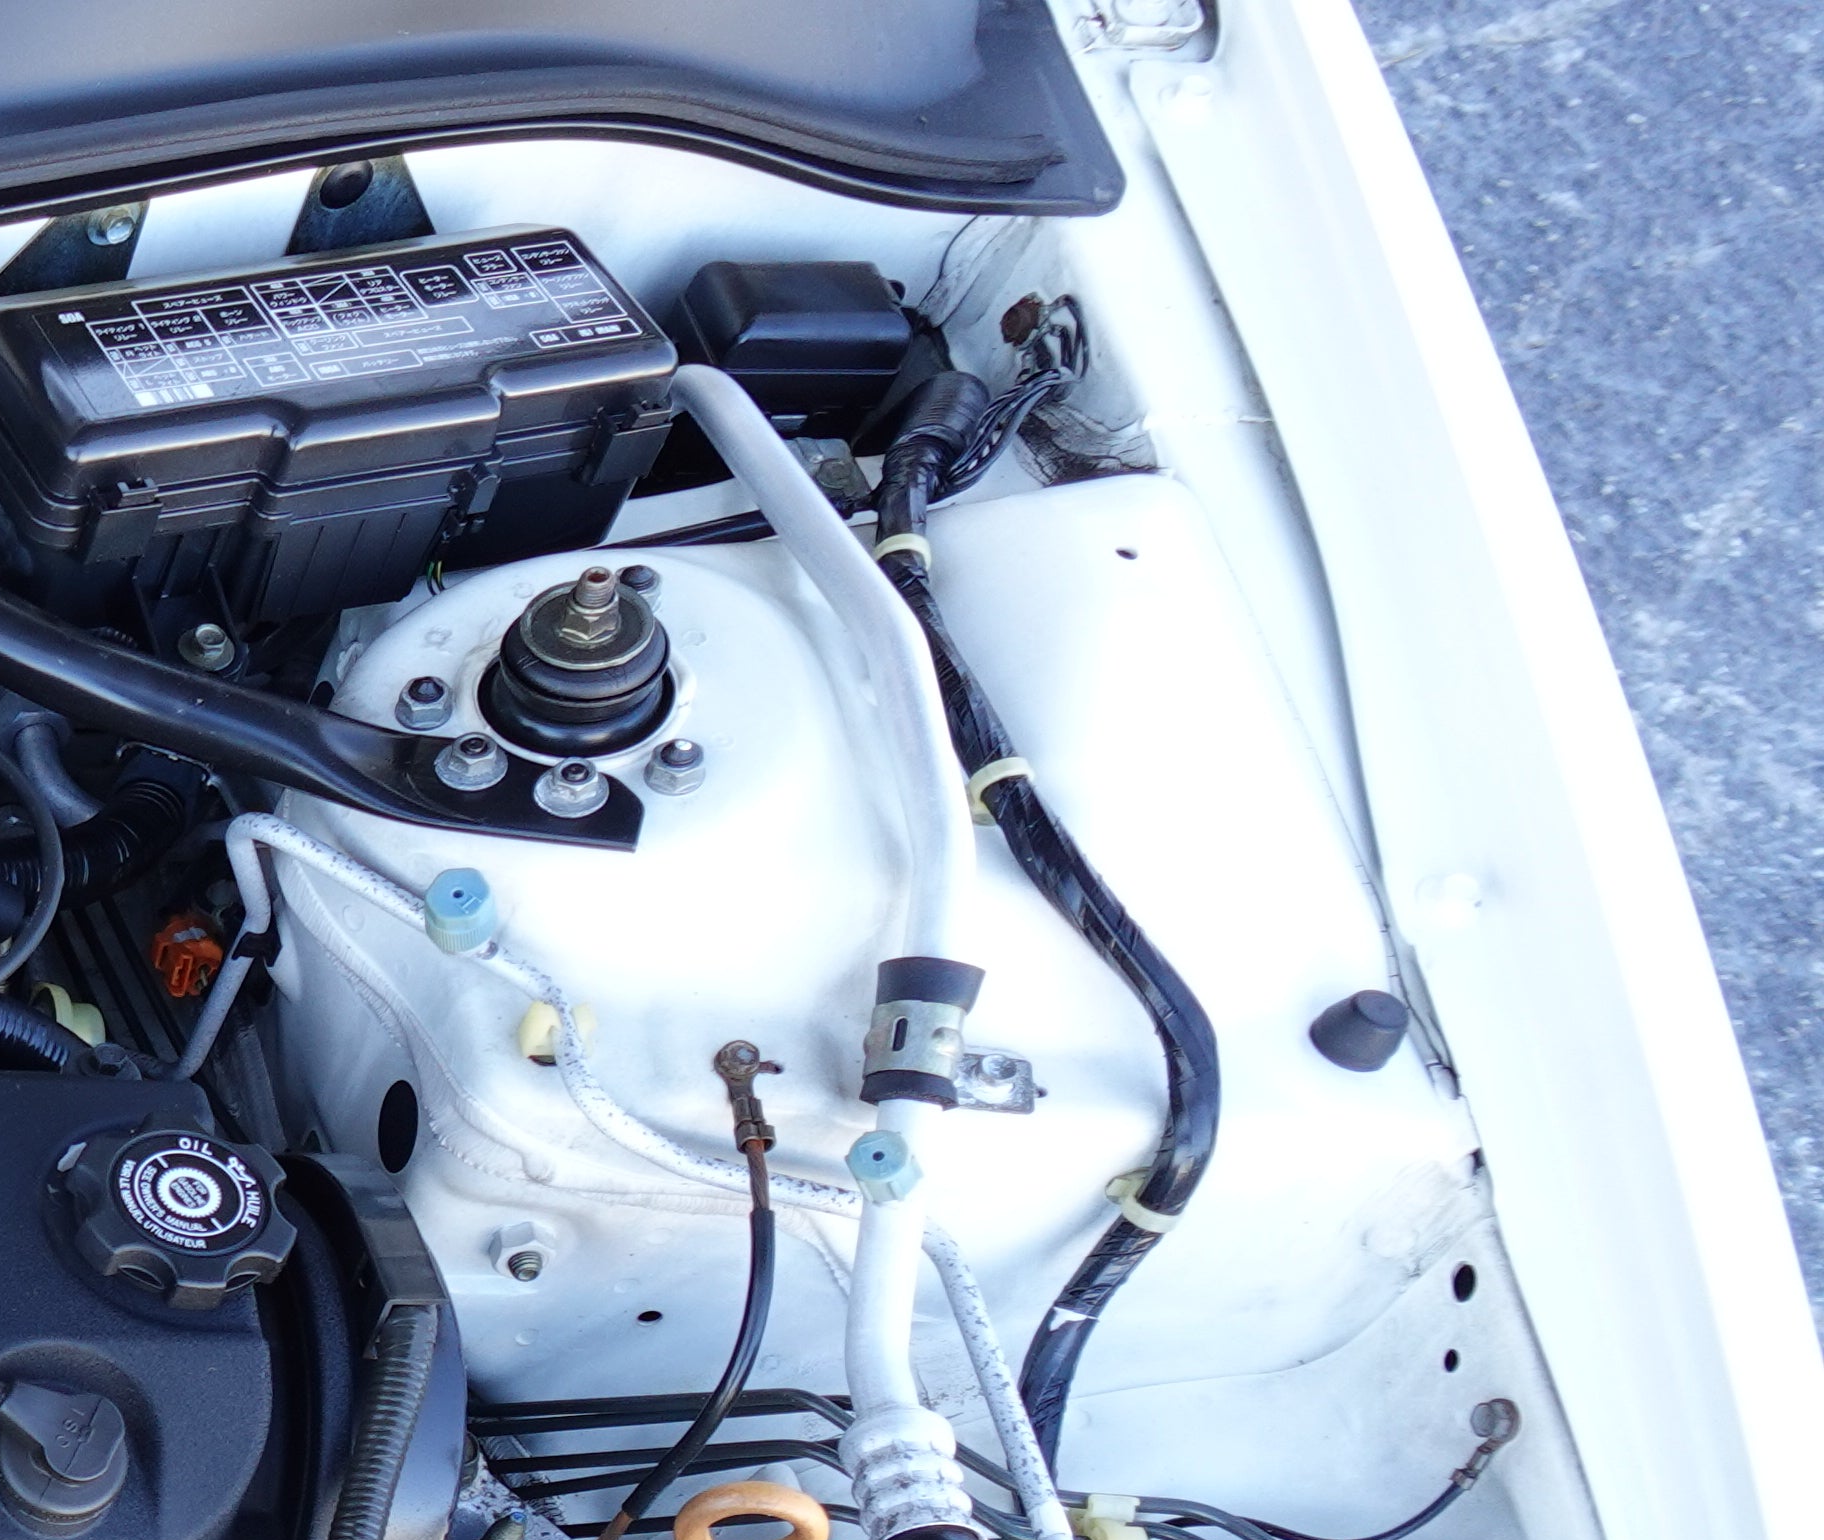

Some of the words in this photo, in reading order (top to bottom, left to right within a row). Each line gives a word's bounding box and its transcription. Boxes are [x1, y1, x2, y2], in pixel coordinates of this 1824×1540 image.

[178, 1137, 213, 1155] OIL
[241, 1190, 261, 1228] HUILE
[142, 1220, 207, 1249] UTILISATEUR
